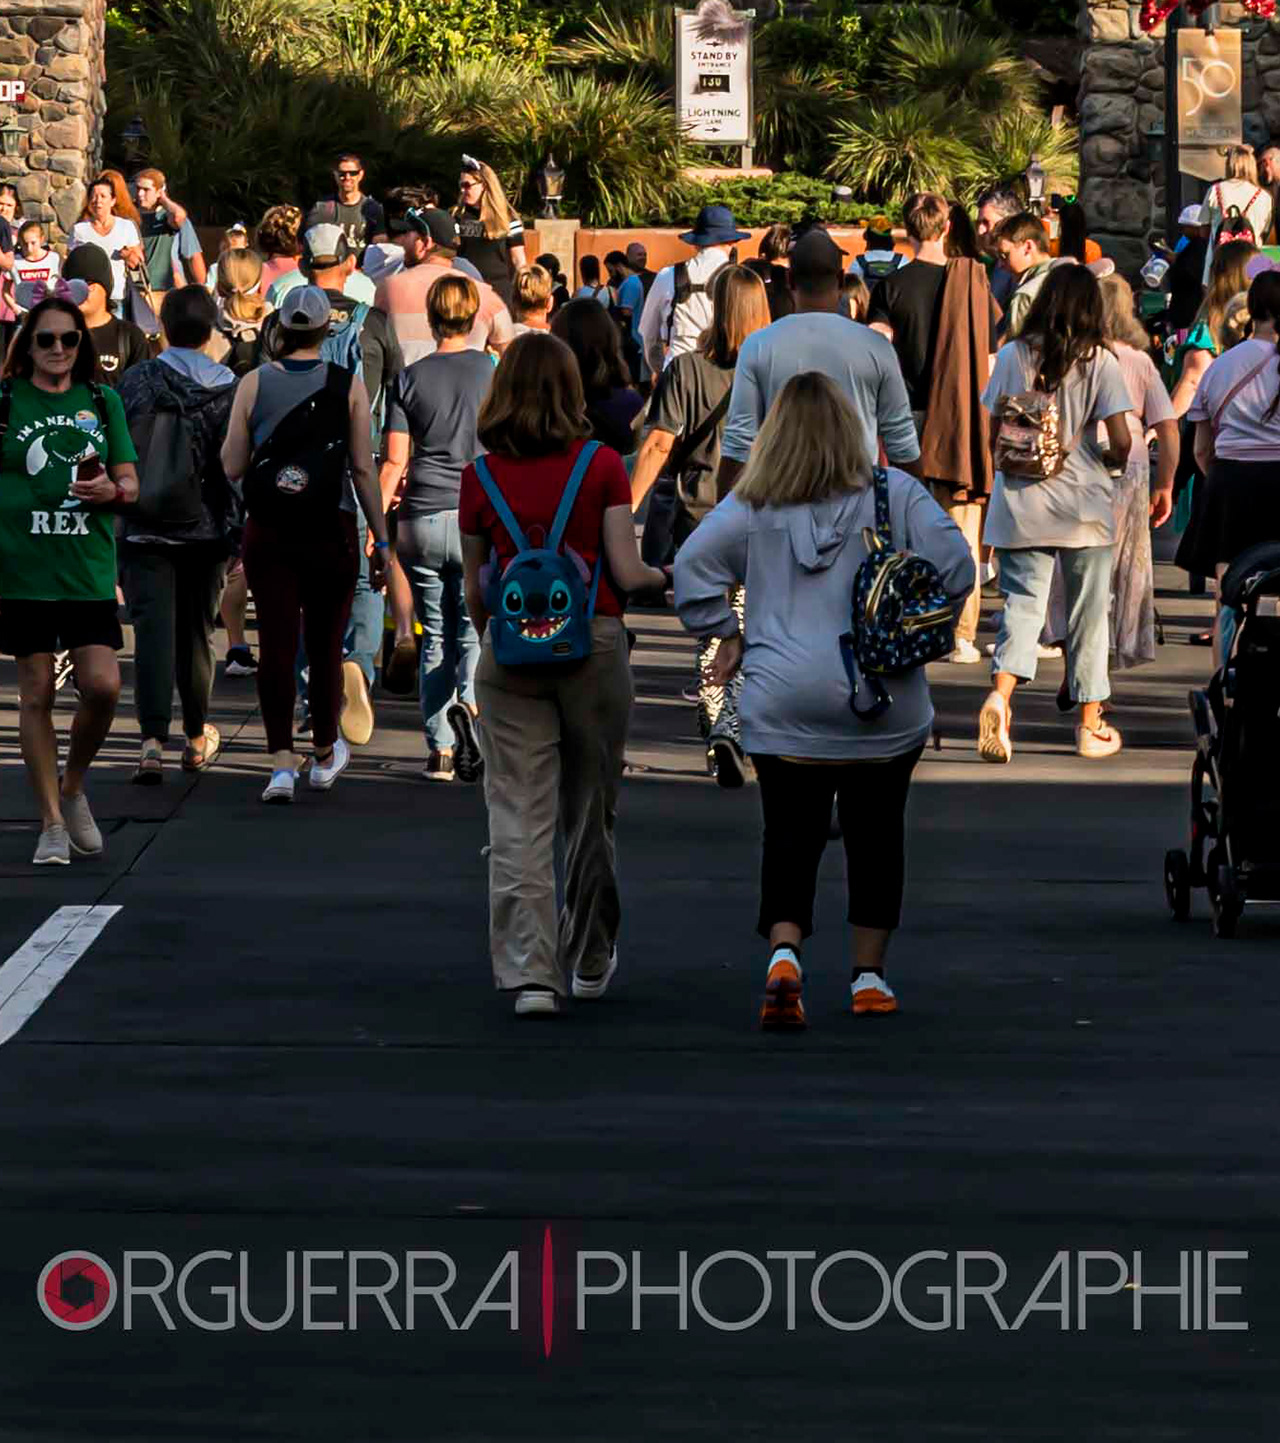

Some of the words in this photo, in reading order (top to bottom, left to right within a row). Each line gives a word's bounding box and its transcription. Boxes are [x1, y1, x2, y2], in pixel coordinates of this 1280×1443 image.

[1181, 57, 1236, 117] 50
[687, 107, 741, 118] LIGHTNING
[34, 420, 45, 430] A
[45, 415, 105, 444] NERUS
[30, 510, 91, 535] REX
